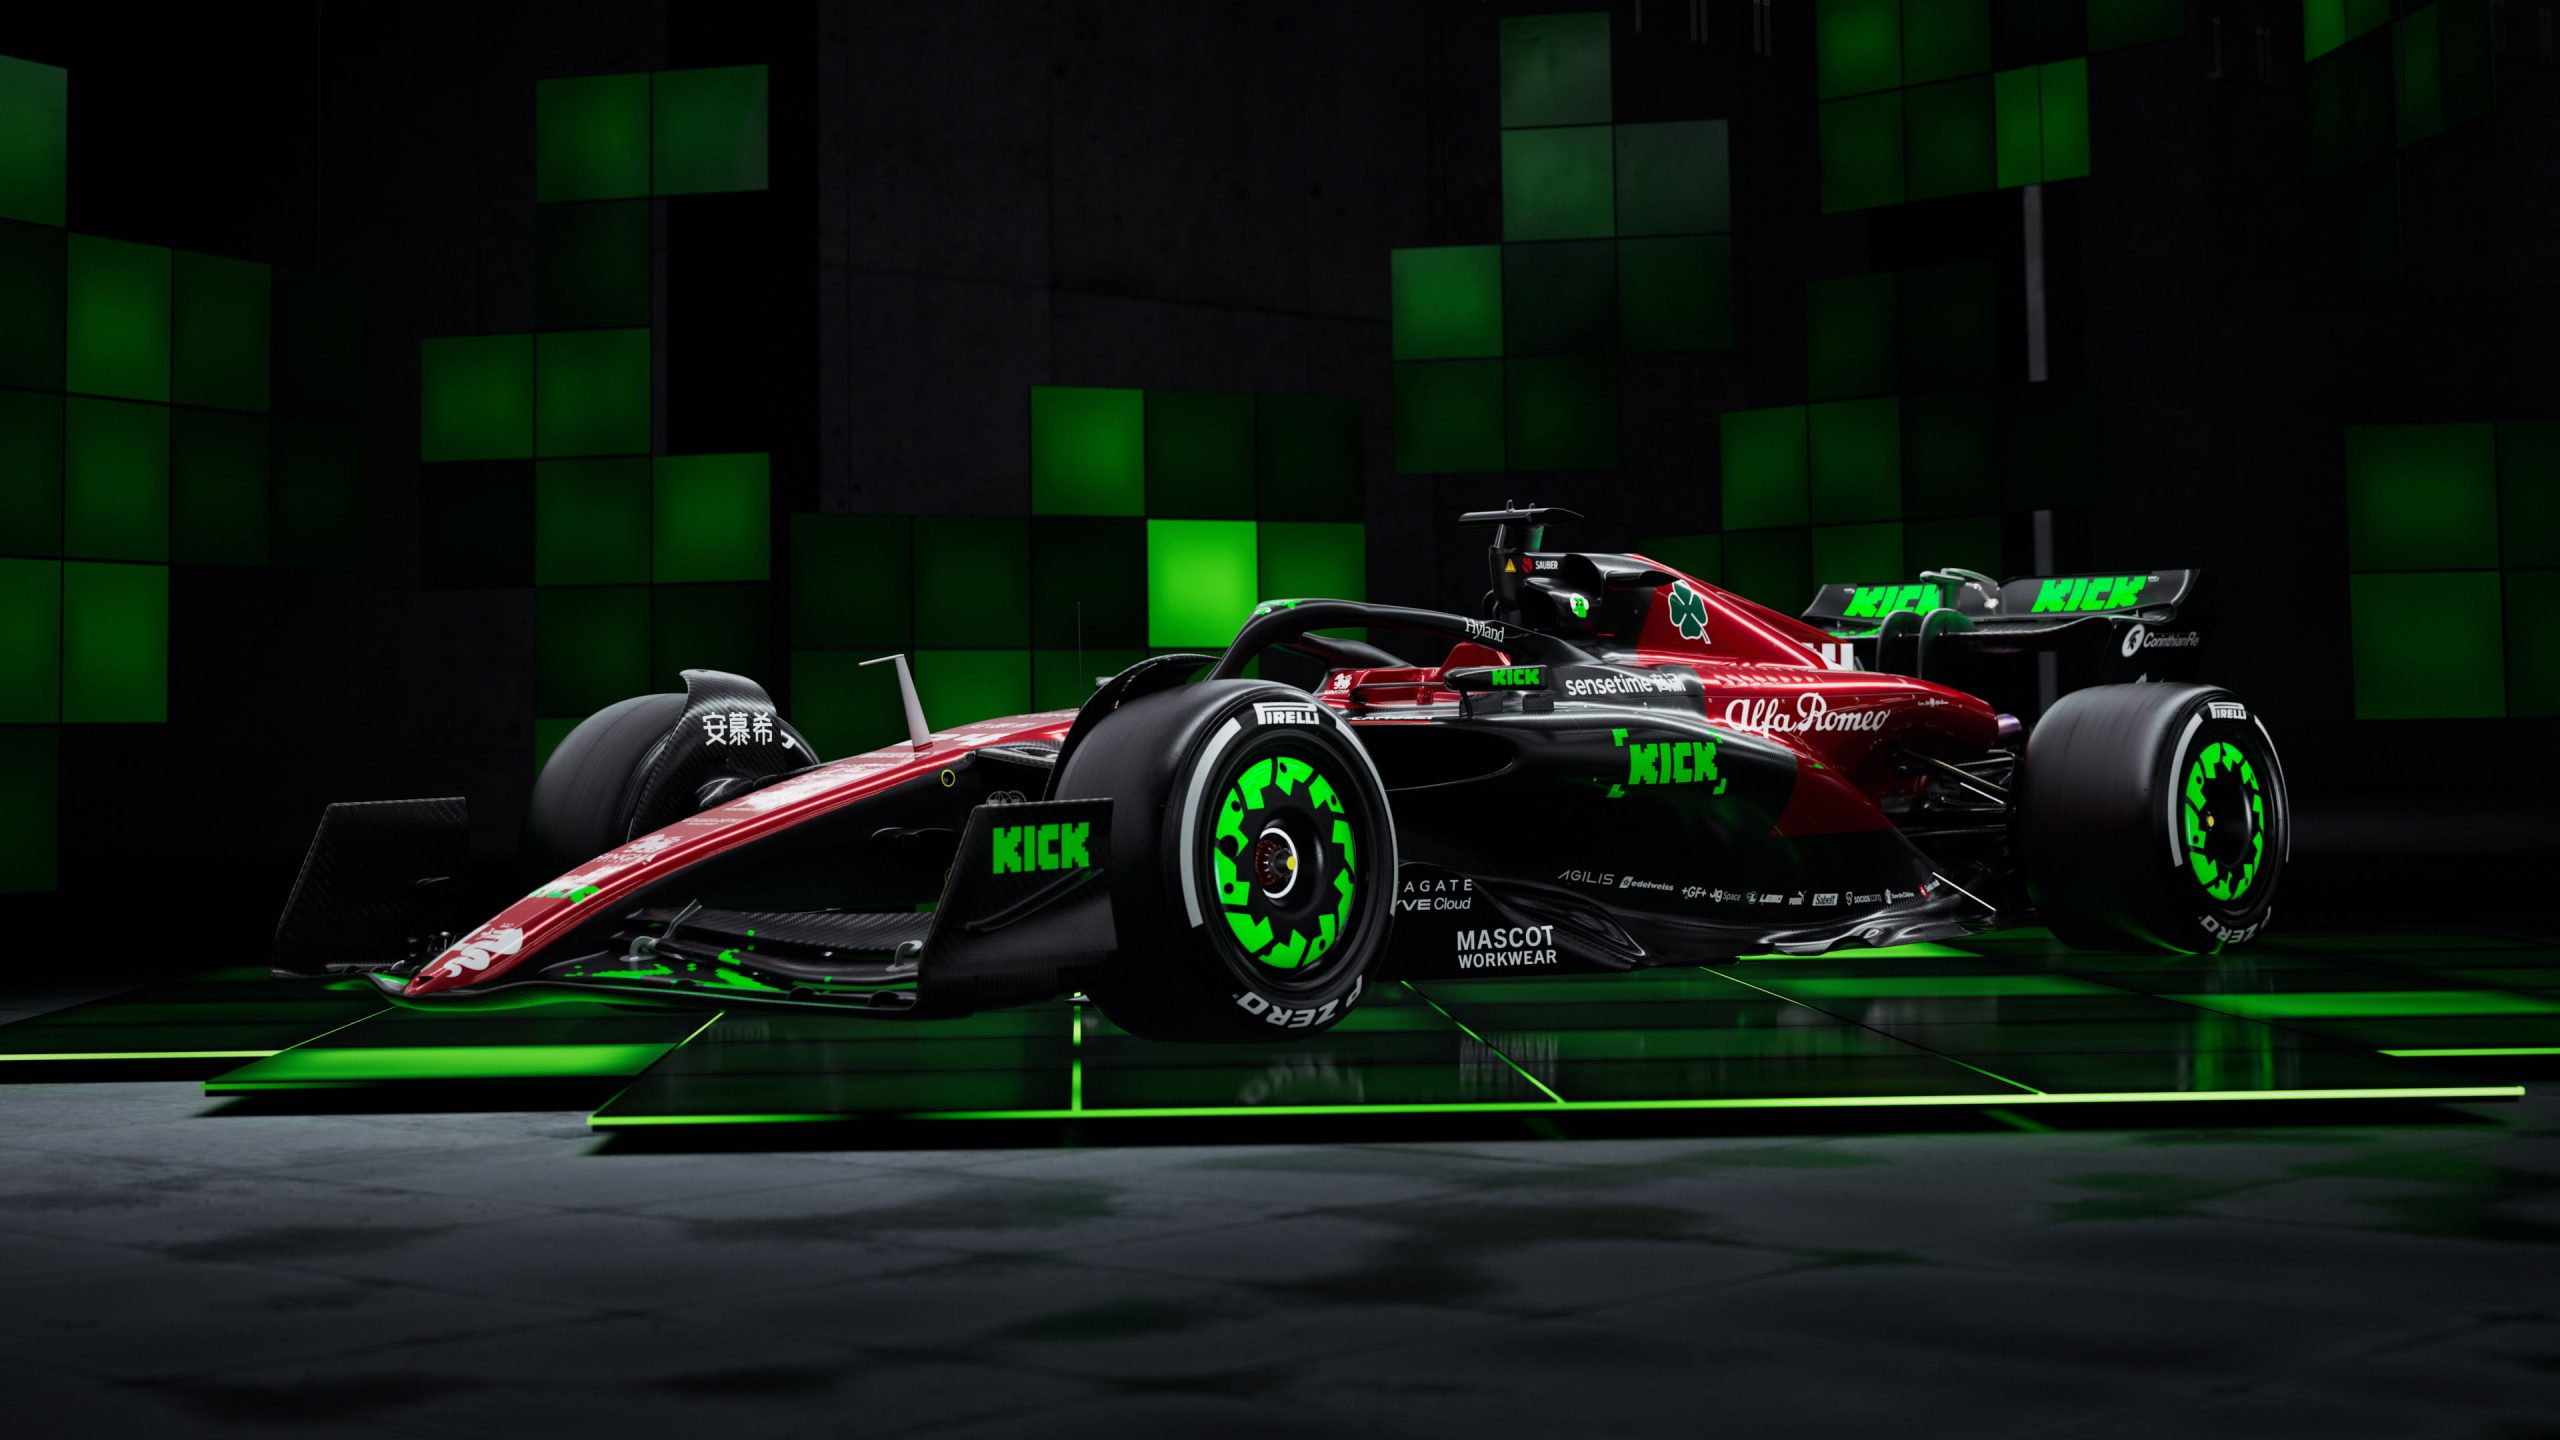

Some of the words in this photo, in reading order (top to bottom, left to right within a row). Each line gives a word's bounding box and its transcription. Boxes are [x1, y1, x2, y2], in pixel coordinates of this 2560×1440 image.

[1535, 560, 1559, 570] SAUBER
[2031, 576, 2147, 612] KICK
[1463, 617, 1505, 643] Hyland
[1492, 668, 1540, 686] KICK
[1565, 674, 1653, 696] sensetime
[1253, 701, 1320, 725] PIRELLI
[1725, 698, 1797, 739] Alfa
[1797, 692, 1891, 736] Romeo
[2208, 702, 2247, 720] PIRELLI
[702, 711, 773, 746] 安慕希
[1628, 742, 1718, 785] KICK
[993, 822, 1090, 874] KICK
[1403, 879, 1473, 893] AGATE
[1434, 897, 1471, 910] Cloud
[1456, 925, 1554, 951] MASCOT
[1457, 950, 1557, 969] WORKWEAR
[1236, 991, 1339, 1029] ZERO
